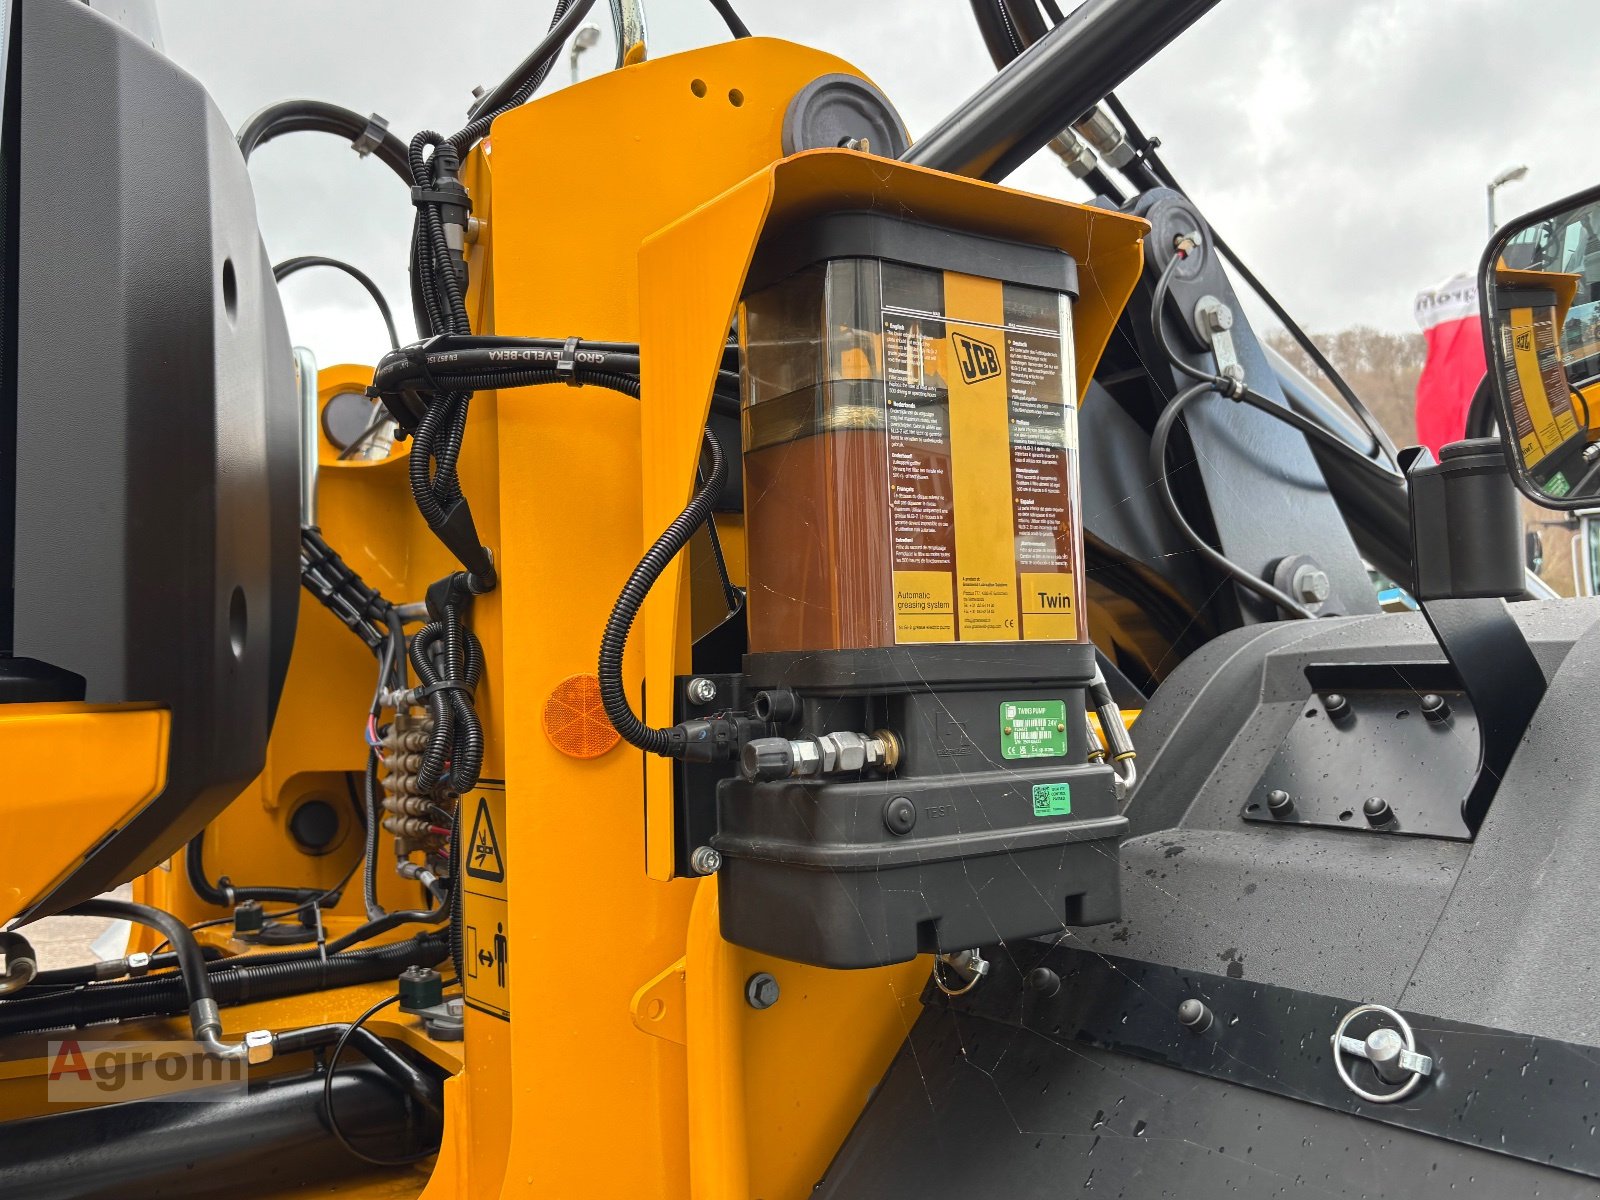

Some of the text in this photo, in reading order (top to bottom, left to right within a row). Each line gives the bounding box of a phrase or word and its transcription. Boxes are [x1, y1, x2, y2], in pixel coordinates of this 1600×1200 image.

[890, 322, 904, 331] English
[489, 351, 605, 364] GROEVELD-BEKA
[961, 340, 998, 379] JCB
[893, 400, 916, 409] Nederlands
[897, 591, 930, 599] Automatic
[1037, 592, 1071, 609] Twin
[897, 601, 950, 610] greasing system
[924, 805, 951, 819] TEST
